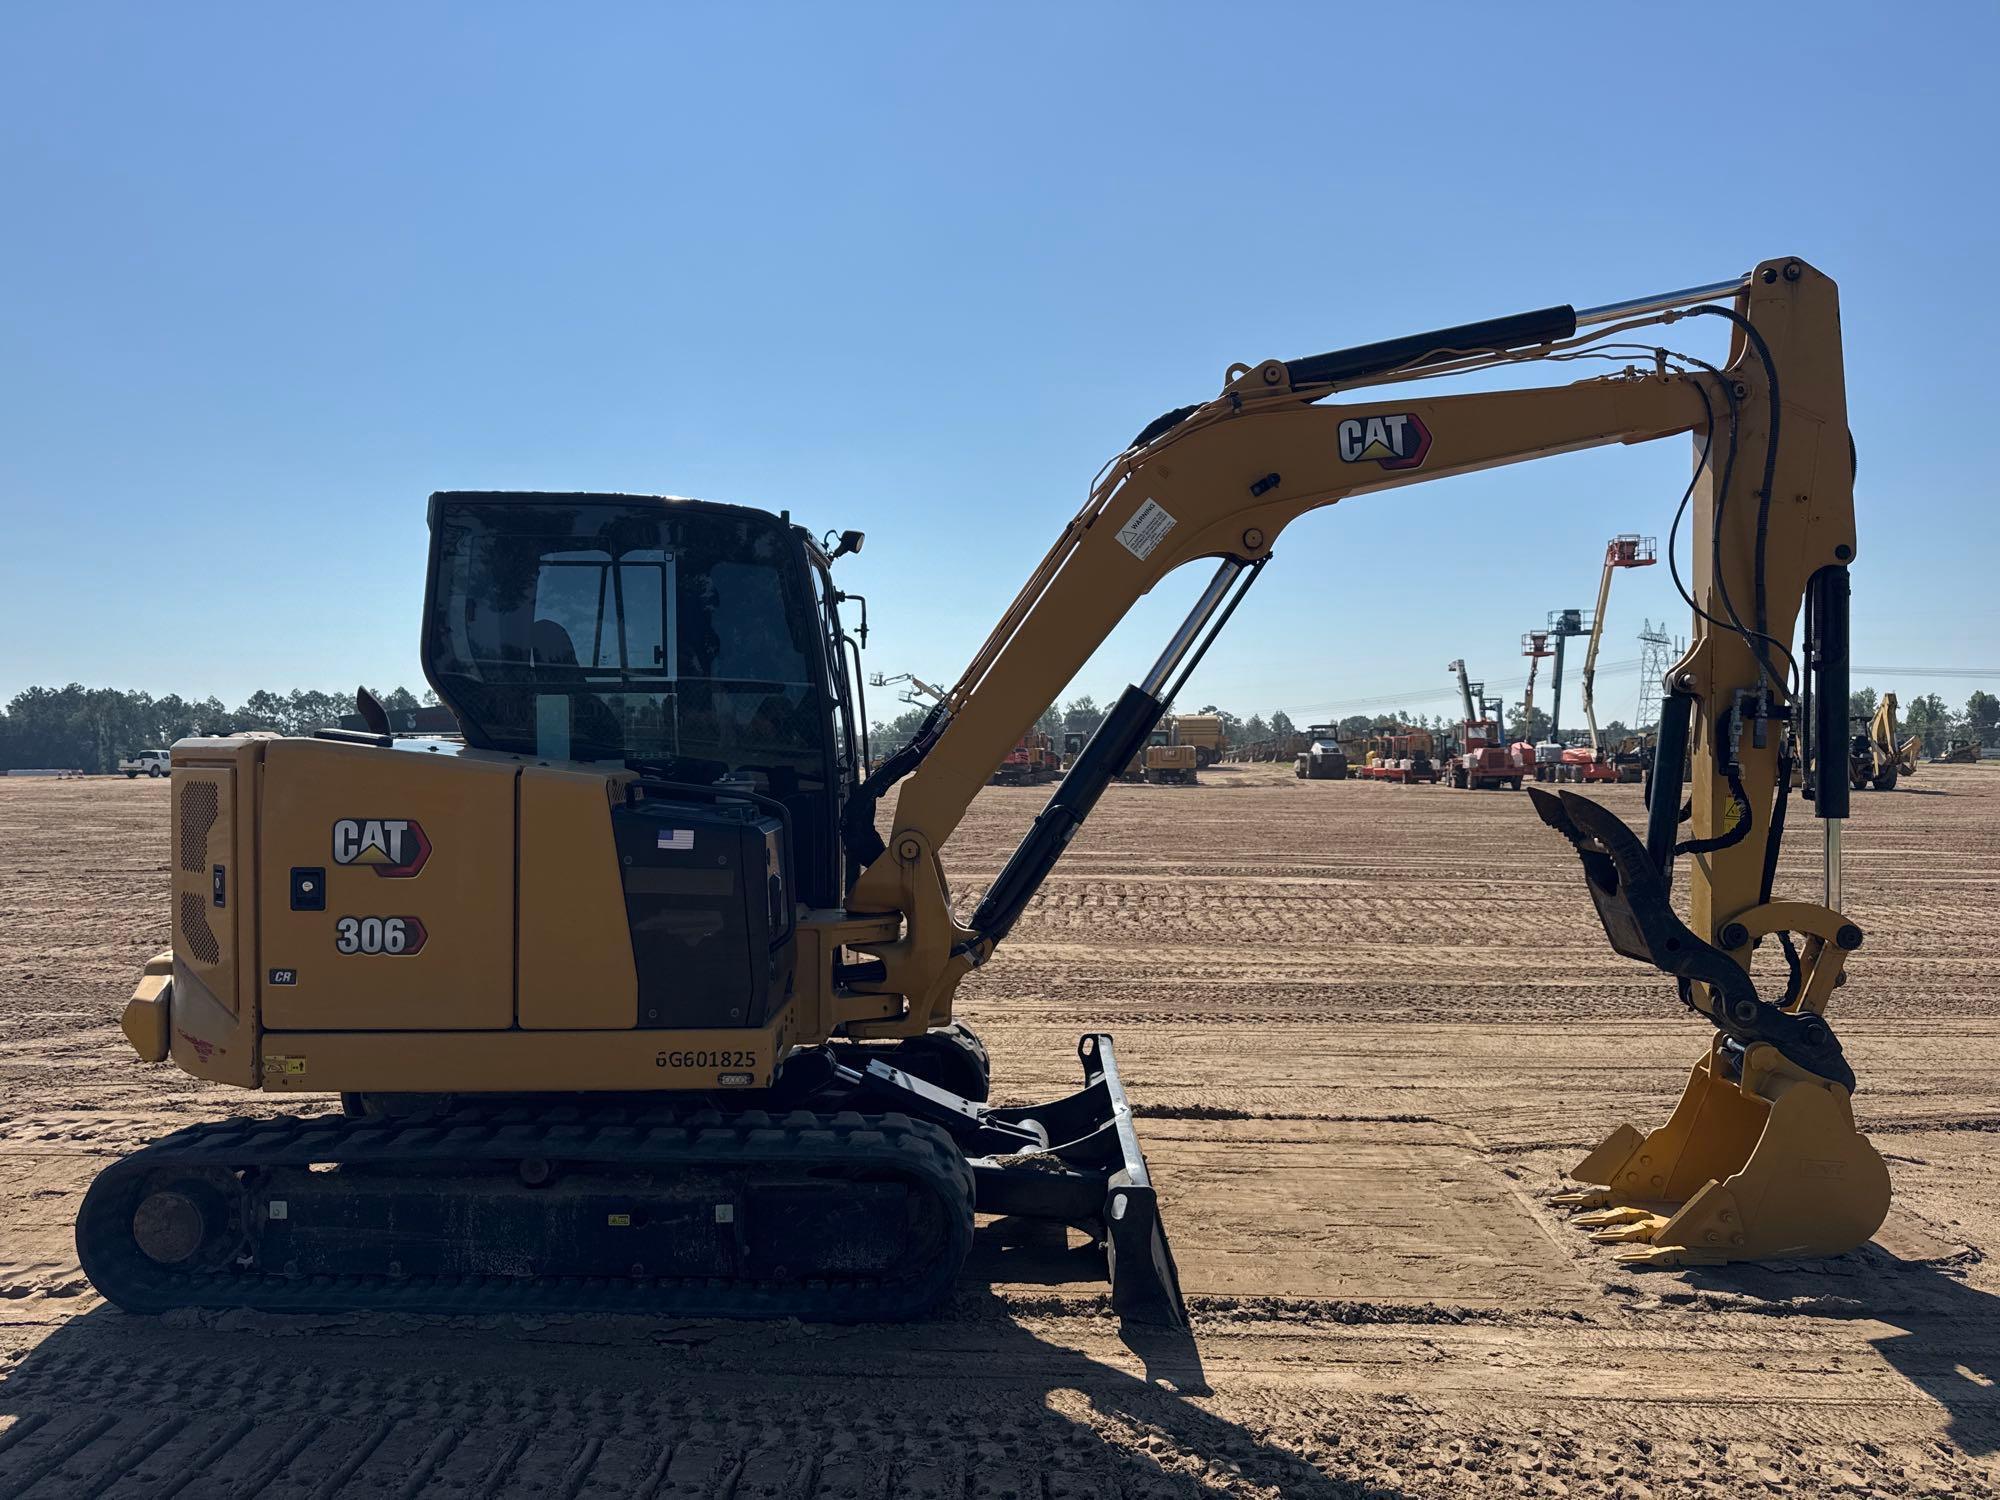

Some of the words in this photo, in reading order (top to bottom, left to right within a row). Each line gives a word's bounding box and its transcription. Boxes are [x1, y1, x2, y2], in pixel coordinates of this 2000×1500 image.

[1339, 414, 1408, 462] CAT
[1131, 503, 1156, 530] WARNING
[334, 819, 408, 864] CAT
[337, 917, 405, 953] 306
[275, 971, 292, 982] CR
[655, 1051, 756, 1068] 6G601825
